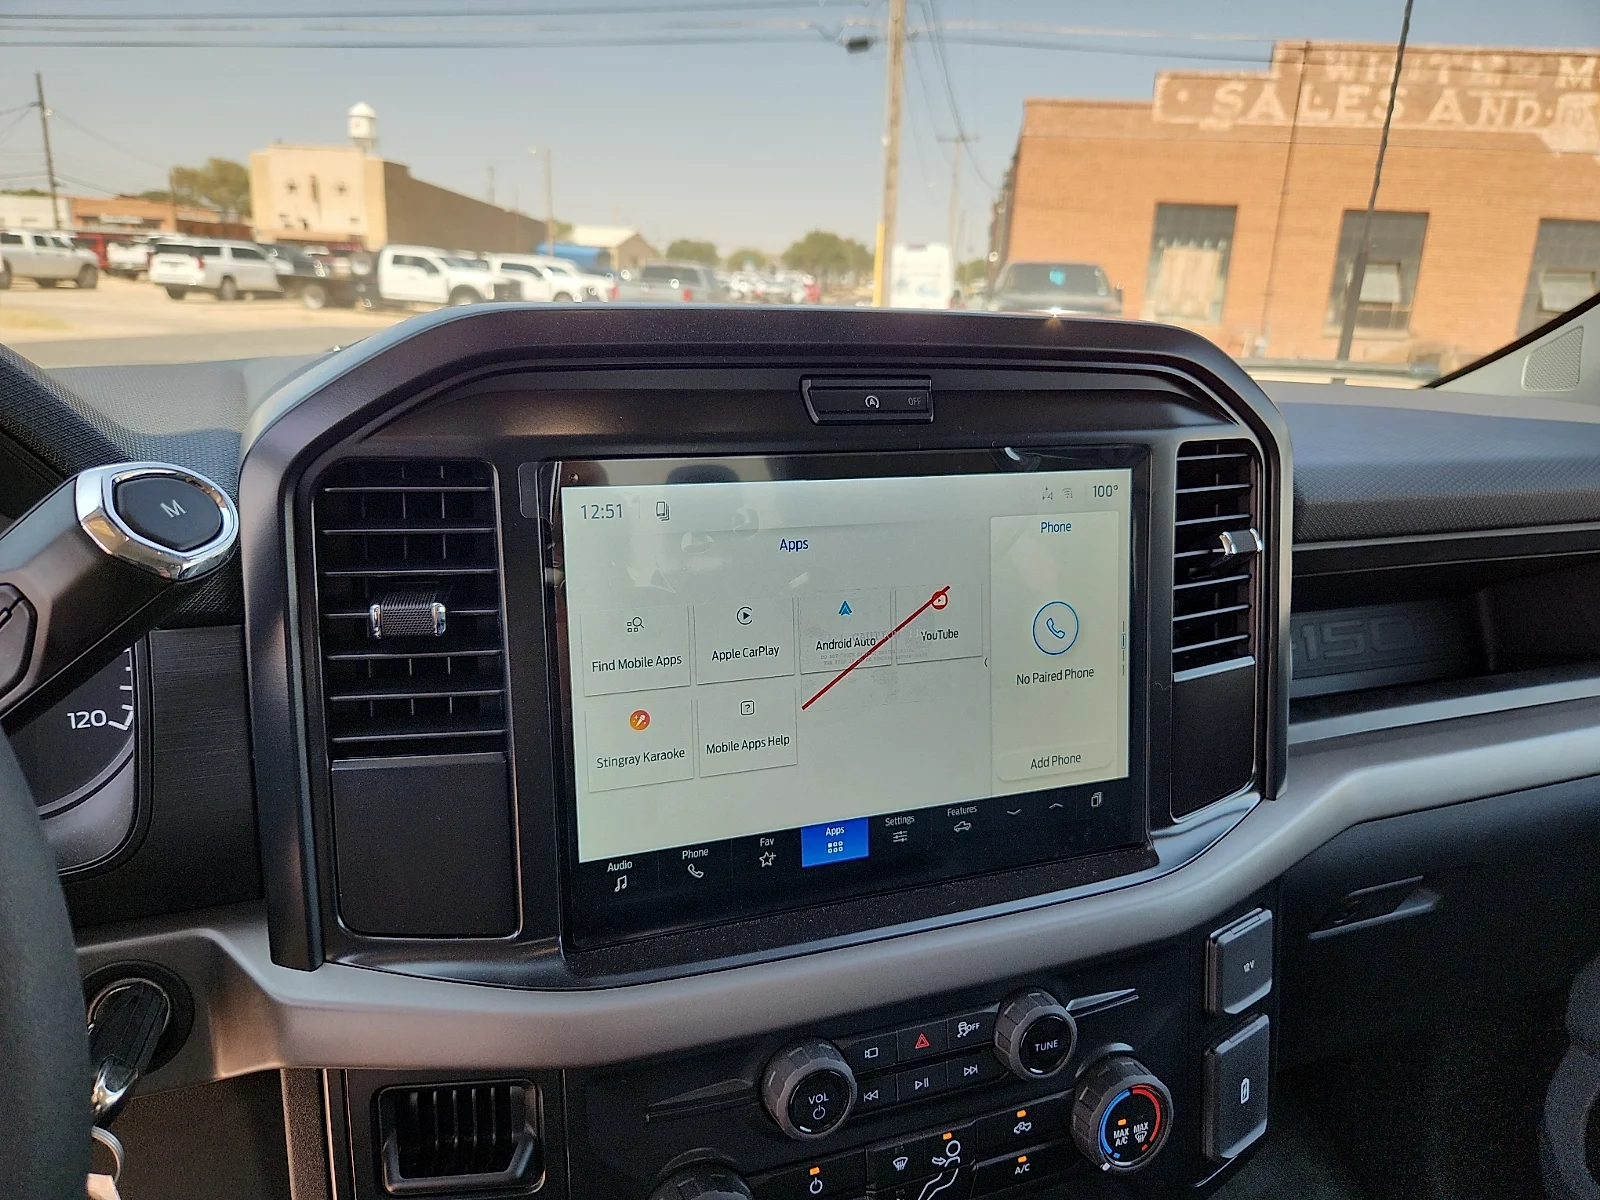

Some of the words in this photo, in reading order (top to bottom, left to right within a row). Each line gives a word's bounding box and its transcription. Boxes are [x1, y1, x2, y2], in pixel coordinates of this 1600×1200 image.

[1210, 80, 1404, 124] SALES
[1427, 89, 1541, 129] AND
[907, 397, 922, 406] OFF
[1092, 484, 1119, 498] 100°
[160, 499, 187, 519] M
[580, 503, 624, 520] 12:51
[1040, 521, 1072, 533] Phone
[779, 538, 809, 552] Apps
[920, 628, 960, 642] YouTube
[815, 637, 852, 652] Android
[853, 636, 876, 648] Auto
[711, 648, 741, 662] Apple
[742, 644, 780, 659] CarPlay
[591, 658, 616, 673] Find
[617, 656, 654, 671] Mobile
[655, 655, 682, 669] Apps
[1016, 673, 1031, 686] No
[1032, 669, 1063, 684] Paired
[1064, 667, 1095, 680] Phone
[67, 708, 108, 730] 120
[706, 740, 740, 755] Mobile
[741, 738, 767, 752] Apps
[767, 734, 790, 749] Help
[596, 753, 641, 769] Stingray
[643, 748, 686, 763] Karaoke
[1030, 755, 1050, 770] Add
[1051, 752, 1082, 767] Phone
[947, 805, 978, 817] Features
[885, 815, 915, 827] Settings
[825, 825, 845, 837] Apps
[759, 836, 775, 847] Fav
[681, 847, 709, 861] Phone
[607, 859, 633, 872] Audio
[967, 1021, 981, 1032] OFF
[1034, 1039, 1059, 1052] TUNE
[808, 1092, 829, 1105] VOL
[1113, 1126, 1130, 1140] MAX
[1132, 1120, 1149, 1134] MAX
[1114, 1135, 1129, 1147] A/C
[1014, 1162, 1031, 1175] A/C
